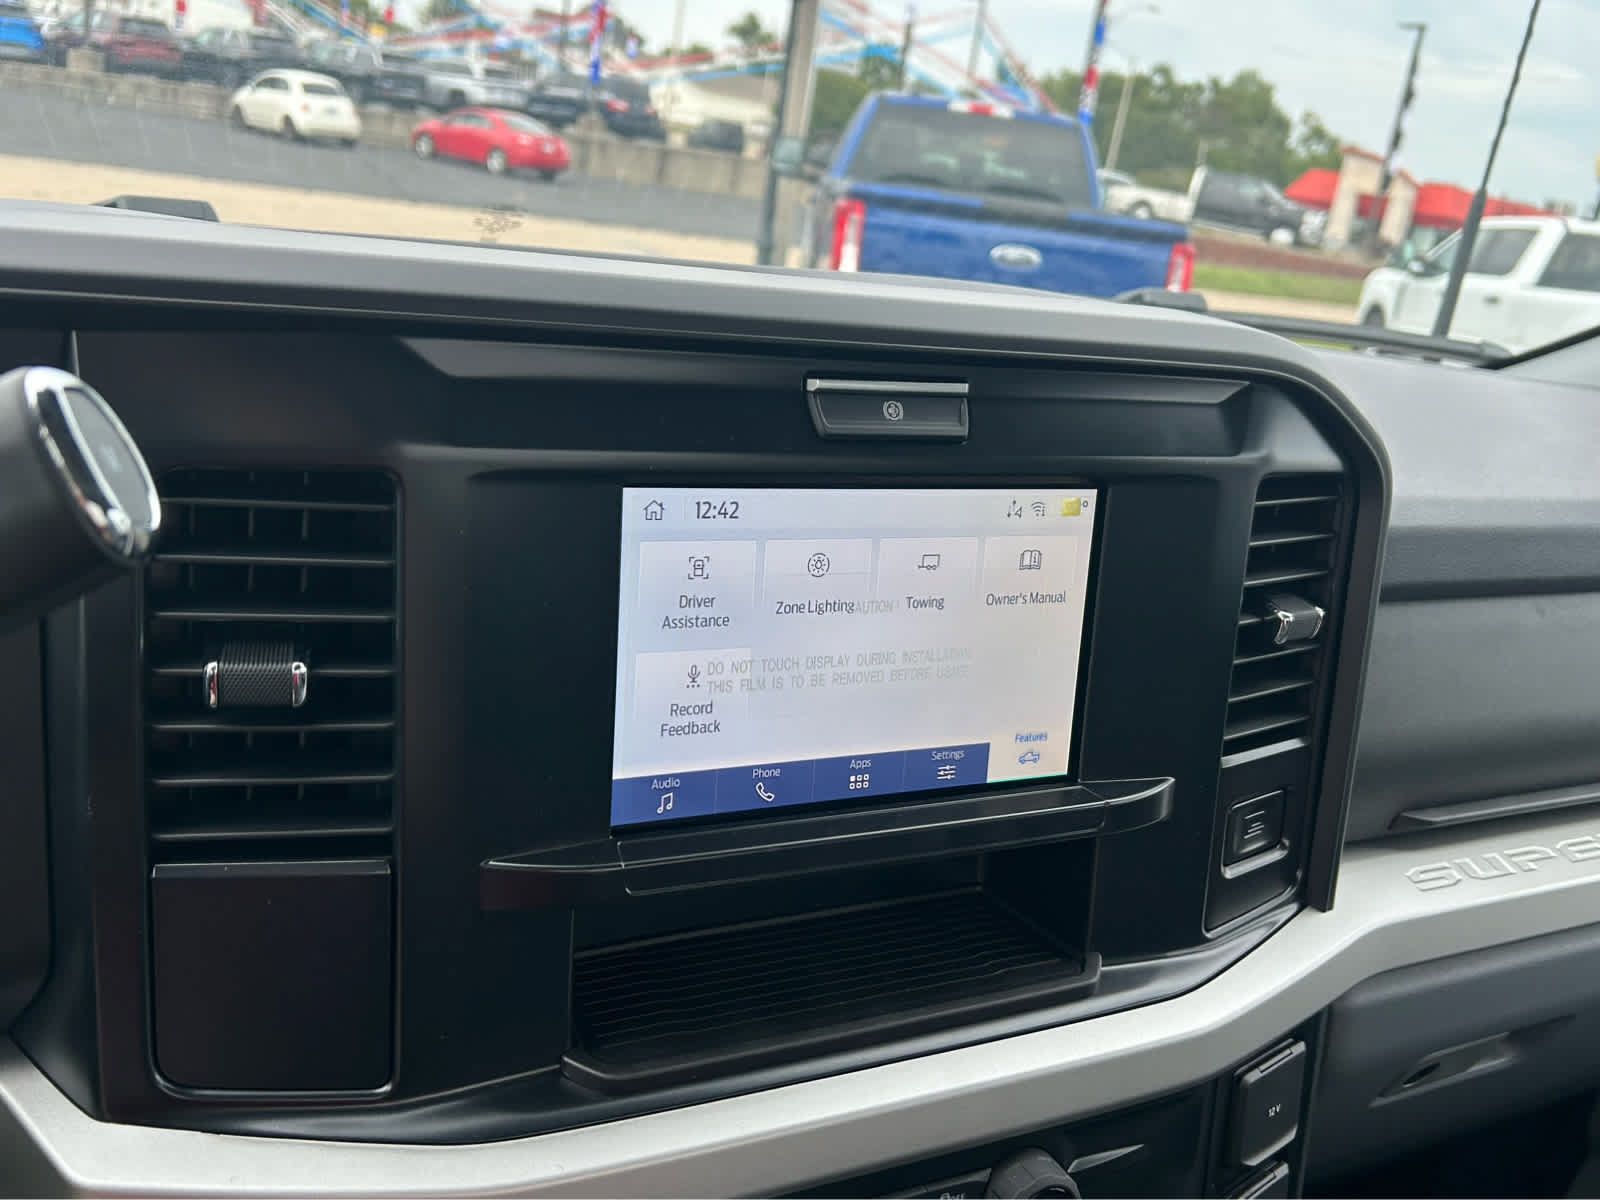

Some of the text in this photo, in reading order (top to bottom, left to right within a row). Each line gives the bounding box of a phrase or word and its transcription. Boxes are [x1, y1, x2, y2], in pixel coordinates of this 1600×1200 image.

[695, 501, 740, 519] 12:42
[679, 595, 716, 608] Driver
[906, 596, 945, 610] Towing
[986, 591, 1066, 606] Owner's Manual
[776, 600, 854, 615] Zone Lighting
[662, 615, 730, 629] Assistance
[706, 660, 725, 676] DO
[731, 659, 754, 674] NOT
[761, 656, 800, 673] TOUCH
[806, 654, 850, 671] DISPLAY
[856, 651, 896, 667] DURING
[707, 679, 733, 694] THIS
[772, 677, 784, 690] IS
[790, 675, 804, 689] TO
[810, 673, 826, 688] BE
[832, 670, 885, 686] REMOVED
[670, 701, 713, 717] Record
[660, 720, 721, 737] Feedback
[1014, 732, 1048, 744] Features
[931, 750, 965, 761] Settings
[849, 758, 872, 770] Apps
[752, 767, 781, 779] Phone
[651, 777, 680, 790] Audio
[1404, 833, 1600, 892] SUPE
